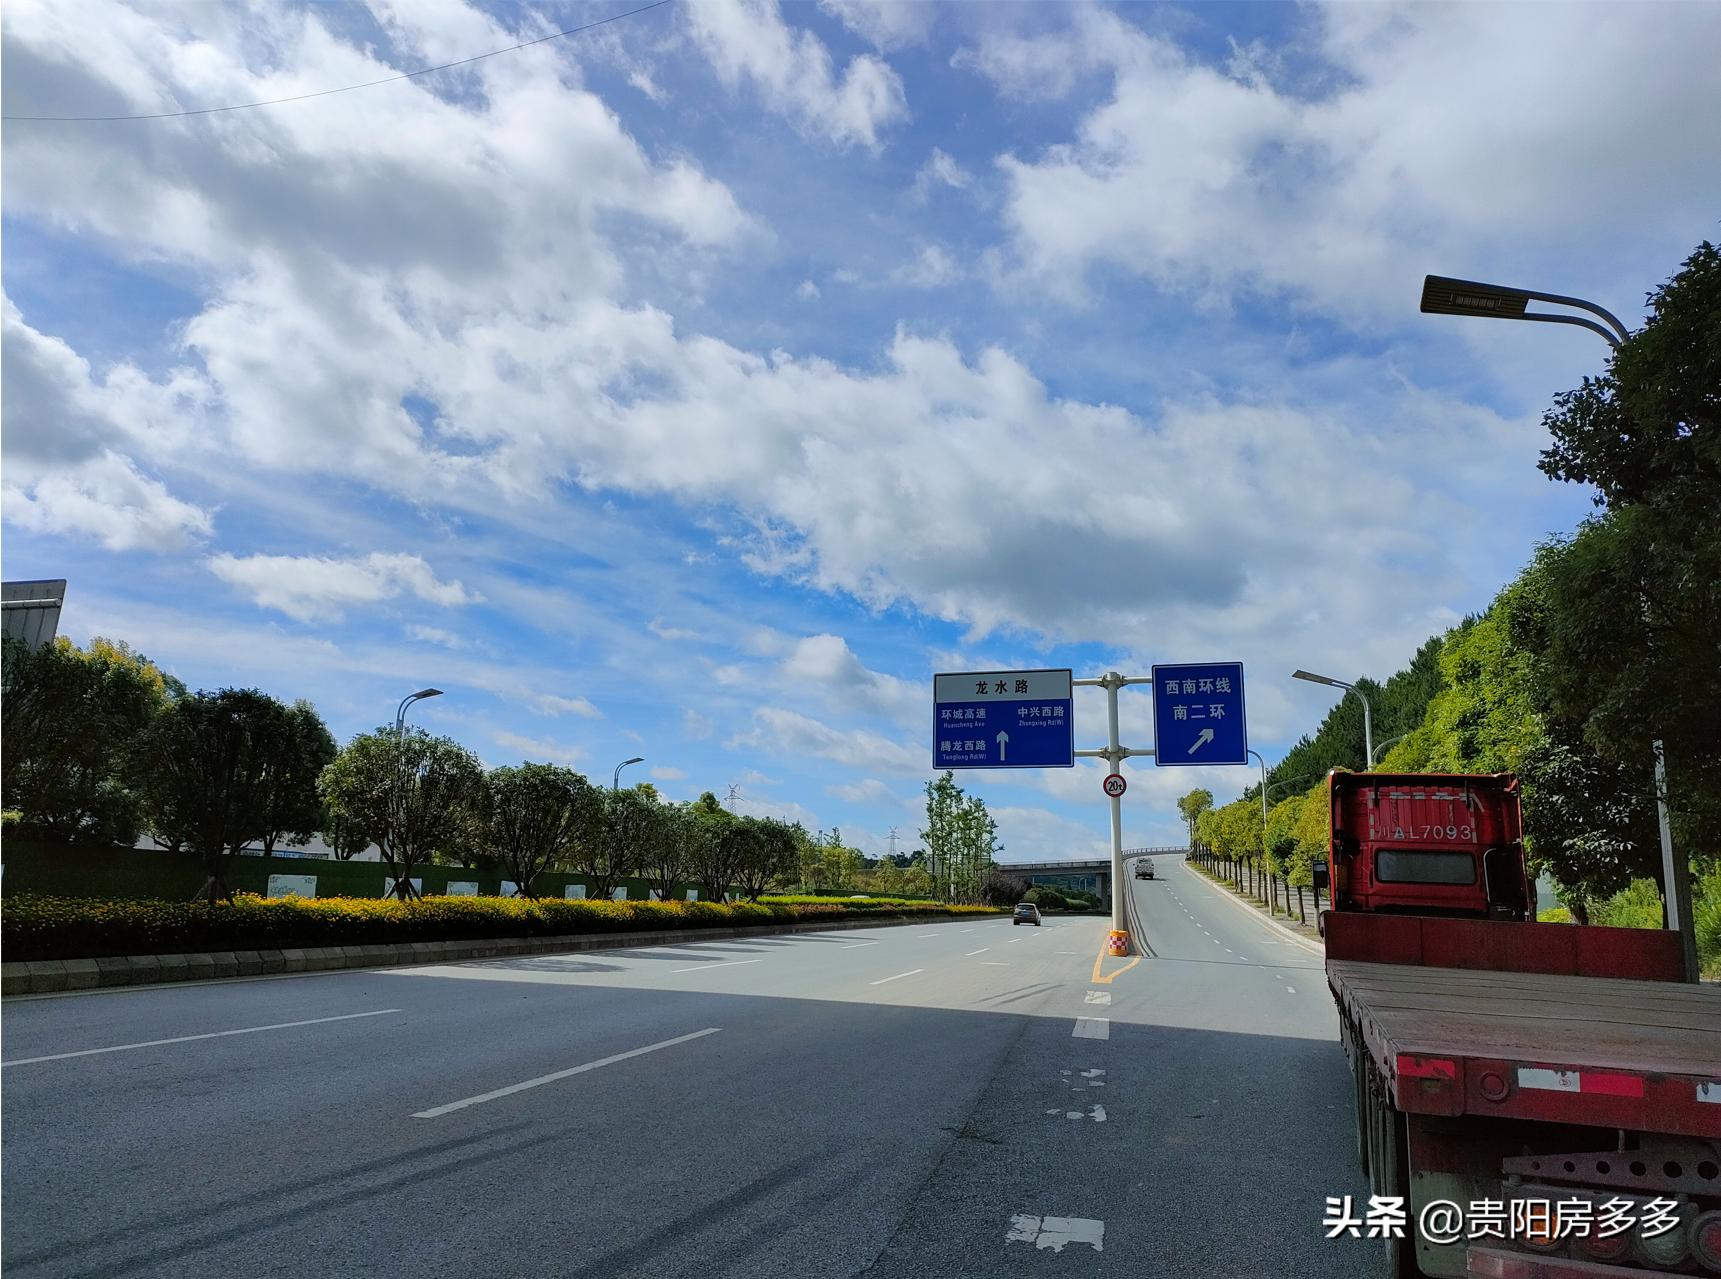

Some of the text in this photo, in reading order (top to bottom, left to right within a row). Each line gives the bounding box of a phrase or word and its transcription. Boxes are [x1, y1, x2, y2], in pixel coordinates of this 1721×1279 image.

[975, 679, 1029, 695] 龙水路
[1165, 677, 1232, 695] 西南环线
[941, 708, 987, 719] 环城高速
[1017, 706, 1065, 718] 中兴西路
[1173, 704, 1226, 720] 南二环
[940, 740, 987, 752] 腾龙西路
[1107, 780, 1123, 792] 20t
